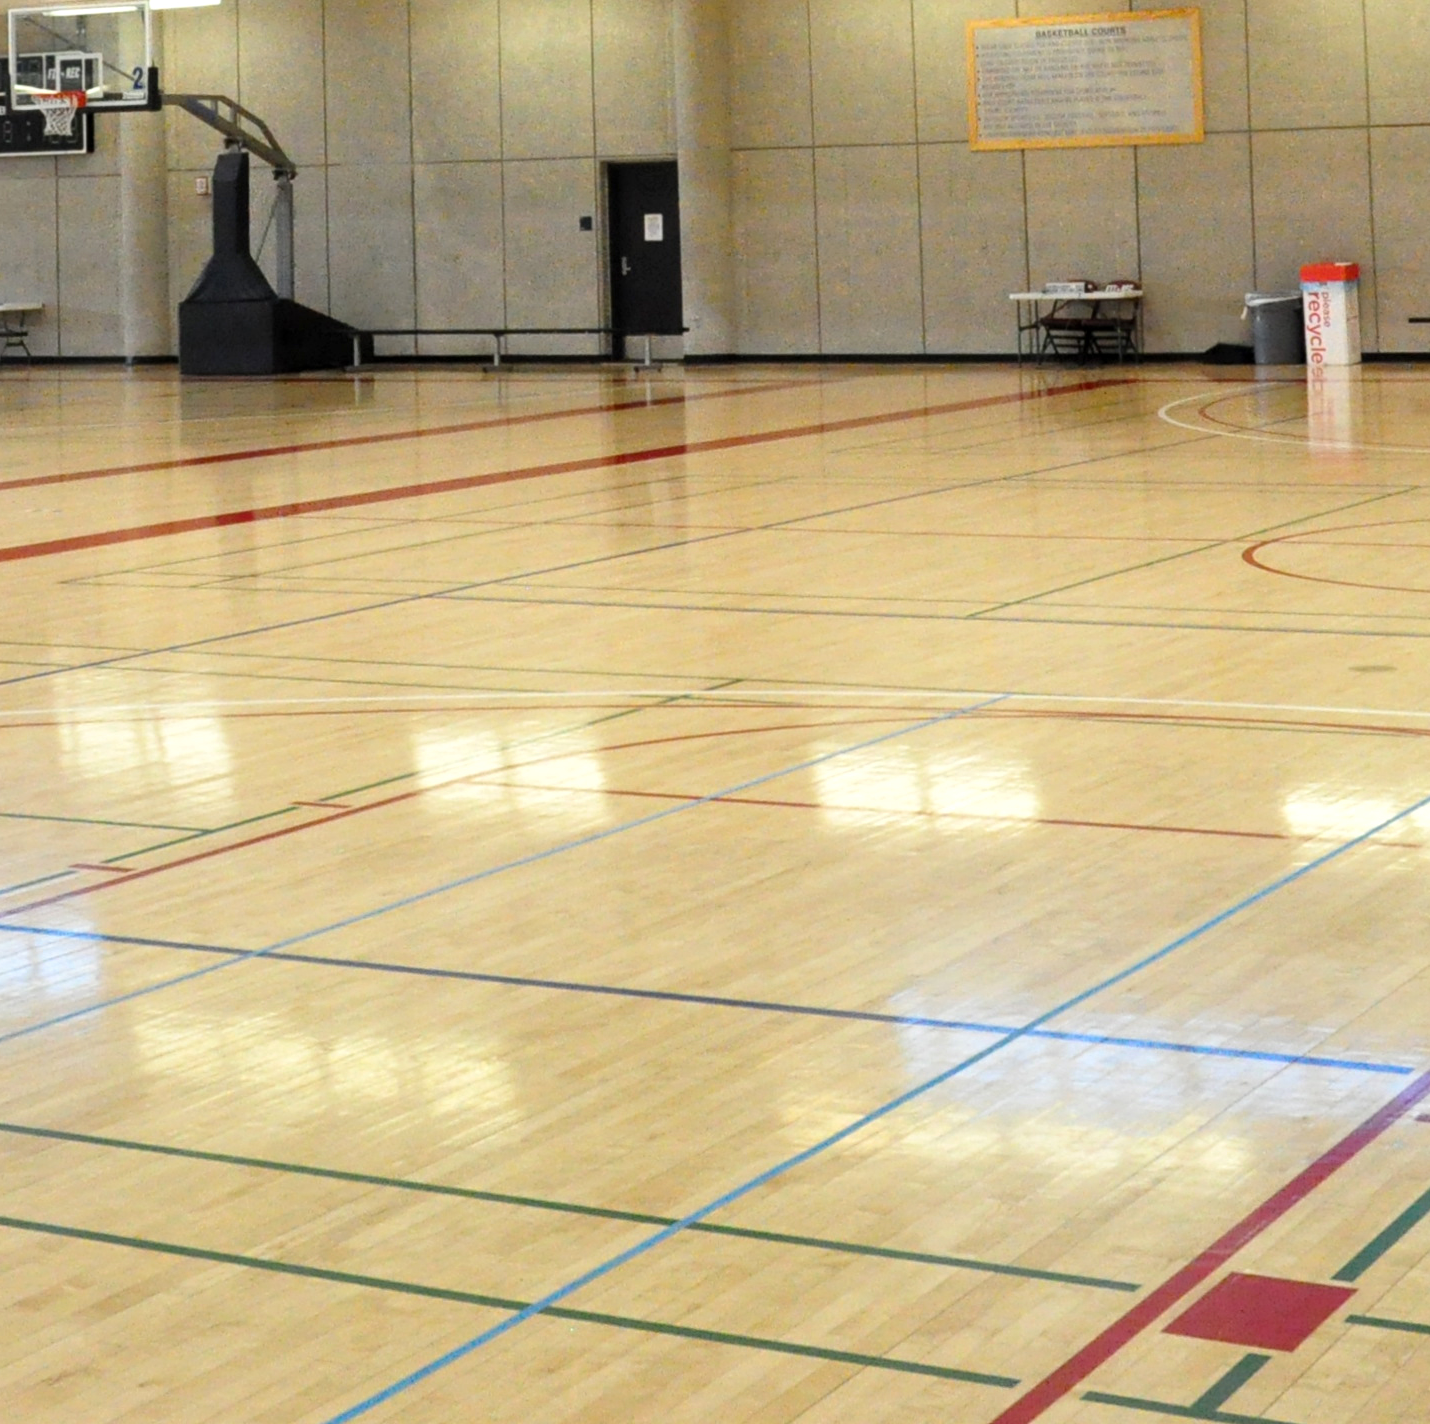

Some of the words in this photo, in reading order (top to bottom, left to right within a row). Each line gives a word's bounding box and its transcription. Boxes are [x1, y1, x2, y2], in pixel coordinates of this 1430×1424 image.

[1035, 28, 1089, 39] BASKETBALL
[1091, 26, 1127, 37] COURTS
[132, 66, 145, 89] 2
[1321, 291, 1331, 328] please
[1307, 292, 1327, 364] recycle
